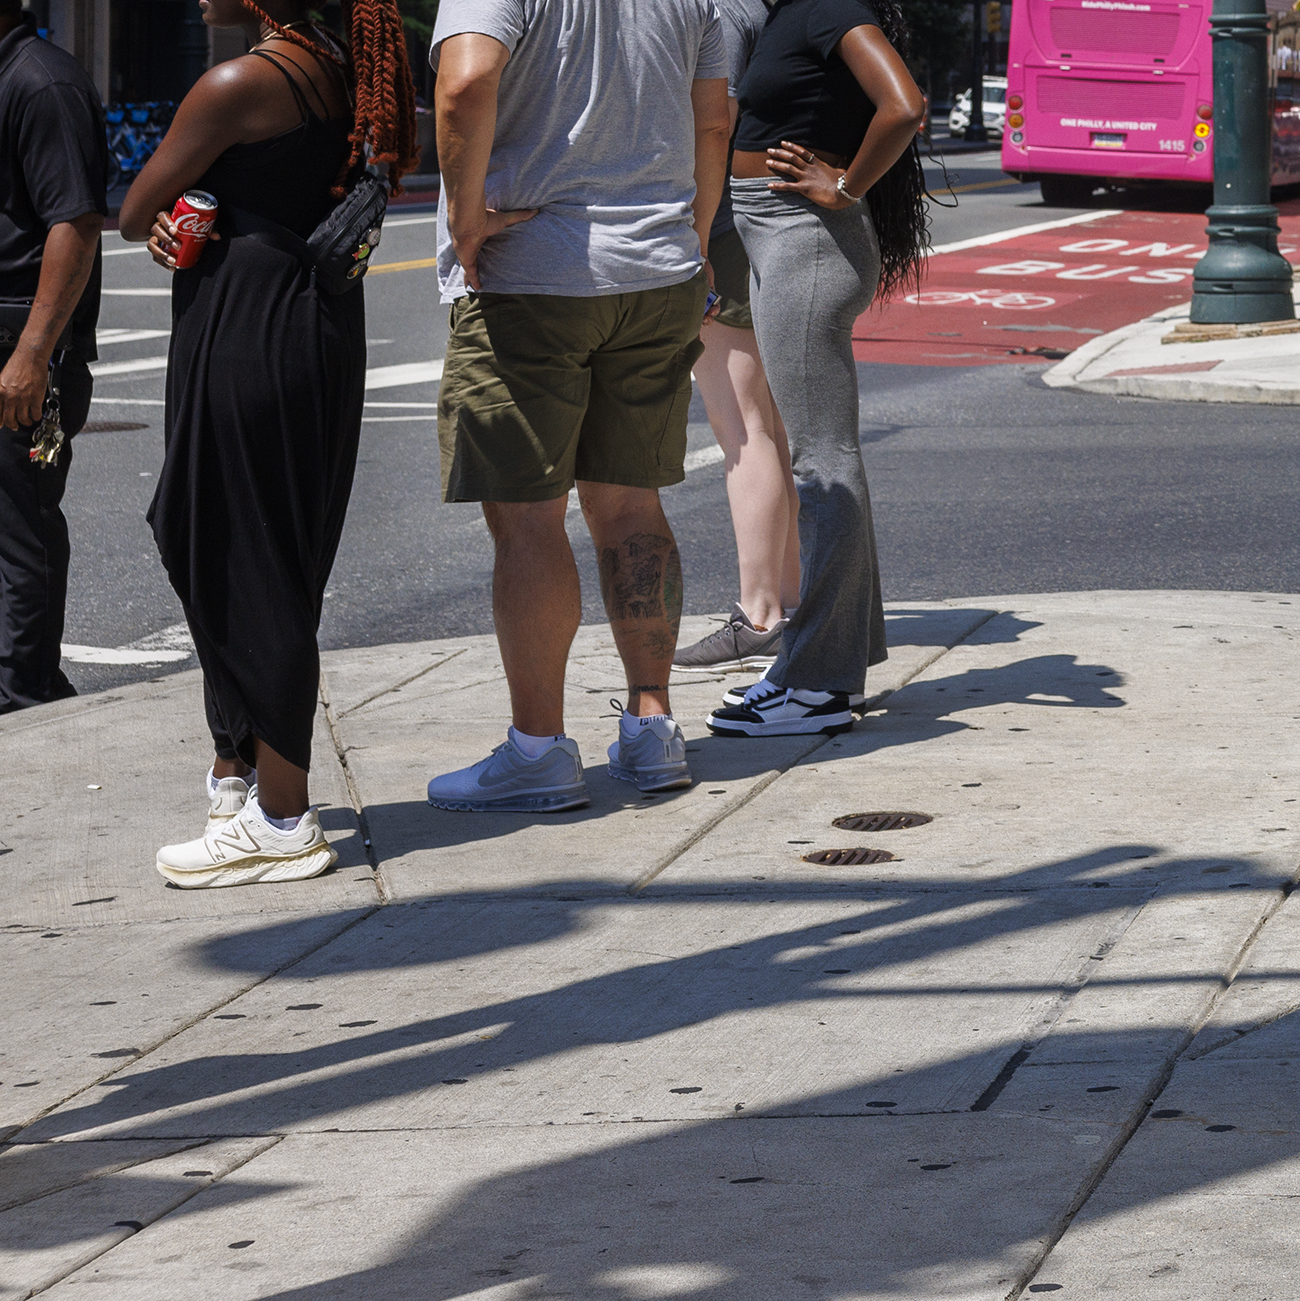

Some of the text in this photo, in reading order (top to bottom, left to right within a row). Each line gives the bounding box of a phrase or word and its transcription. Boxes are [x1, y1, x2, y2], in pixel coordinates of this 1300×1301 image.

[1060, 118, 1076, 127] ONE
[1105, 120, 1111, 129] A
[1112, 121, 1139, 130] UNITED
[1139, 122, 1157, 131] CITY
[1158, 139, 1185, 151] 1415
[976, 259, 1195, 284] BUS
